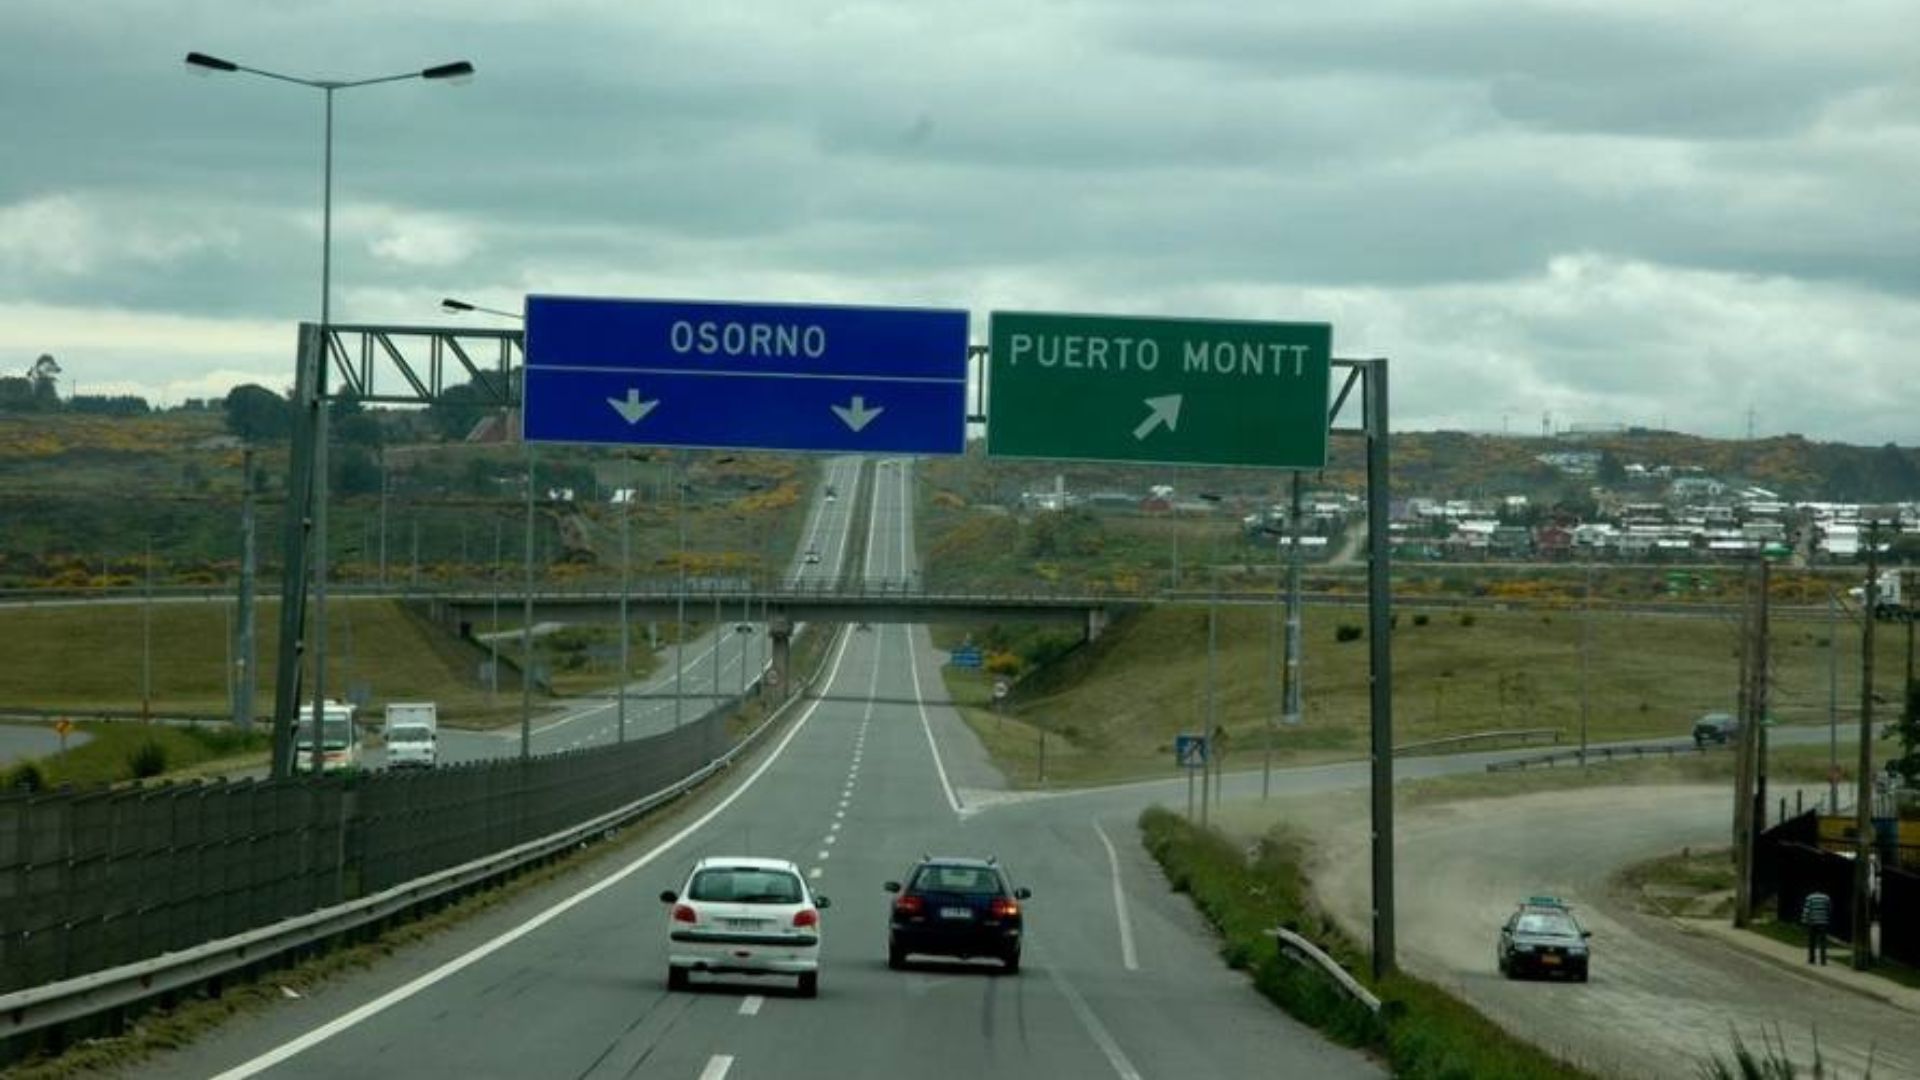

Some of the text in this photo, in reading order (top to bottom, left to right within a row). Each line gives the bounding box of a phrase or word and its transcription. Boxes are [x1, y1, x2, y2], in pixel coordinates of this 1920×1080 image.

[670, 319, 827, 359] OSORNO
[1009, 333, 1311, 377] PUERTO MONTT
